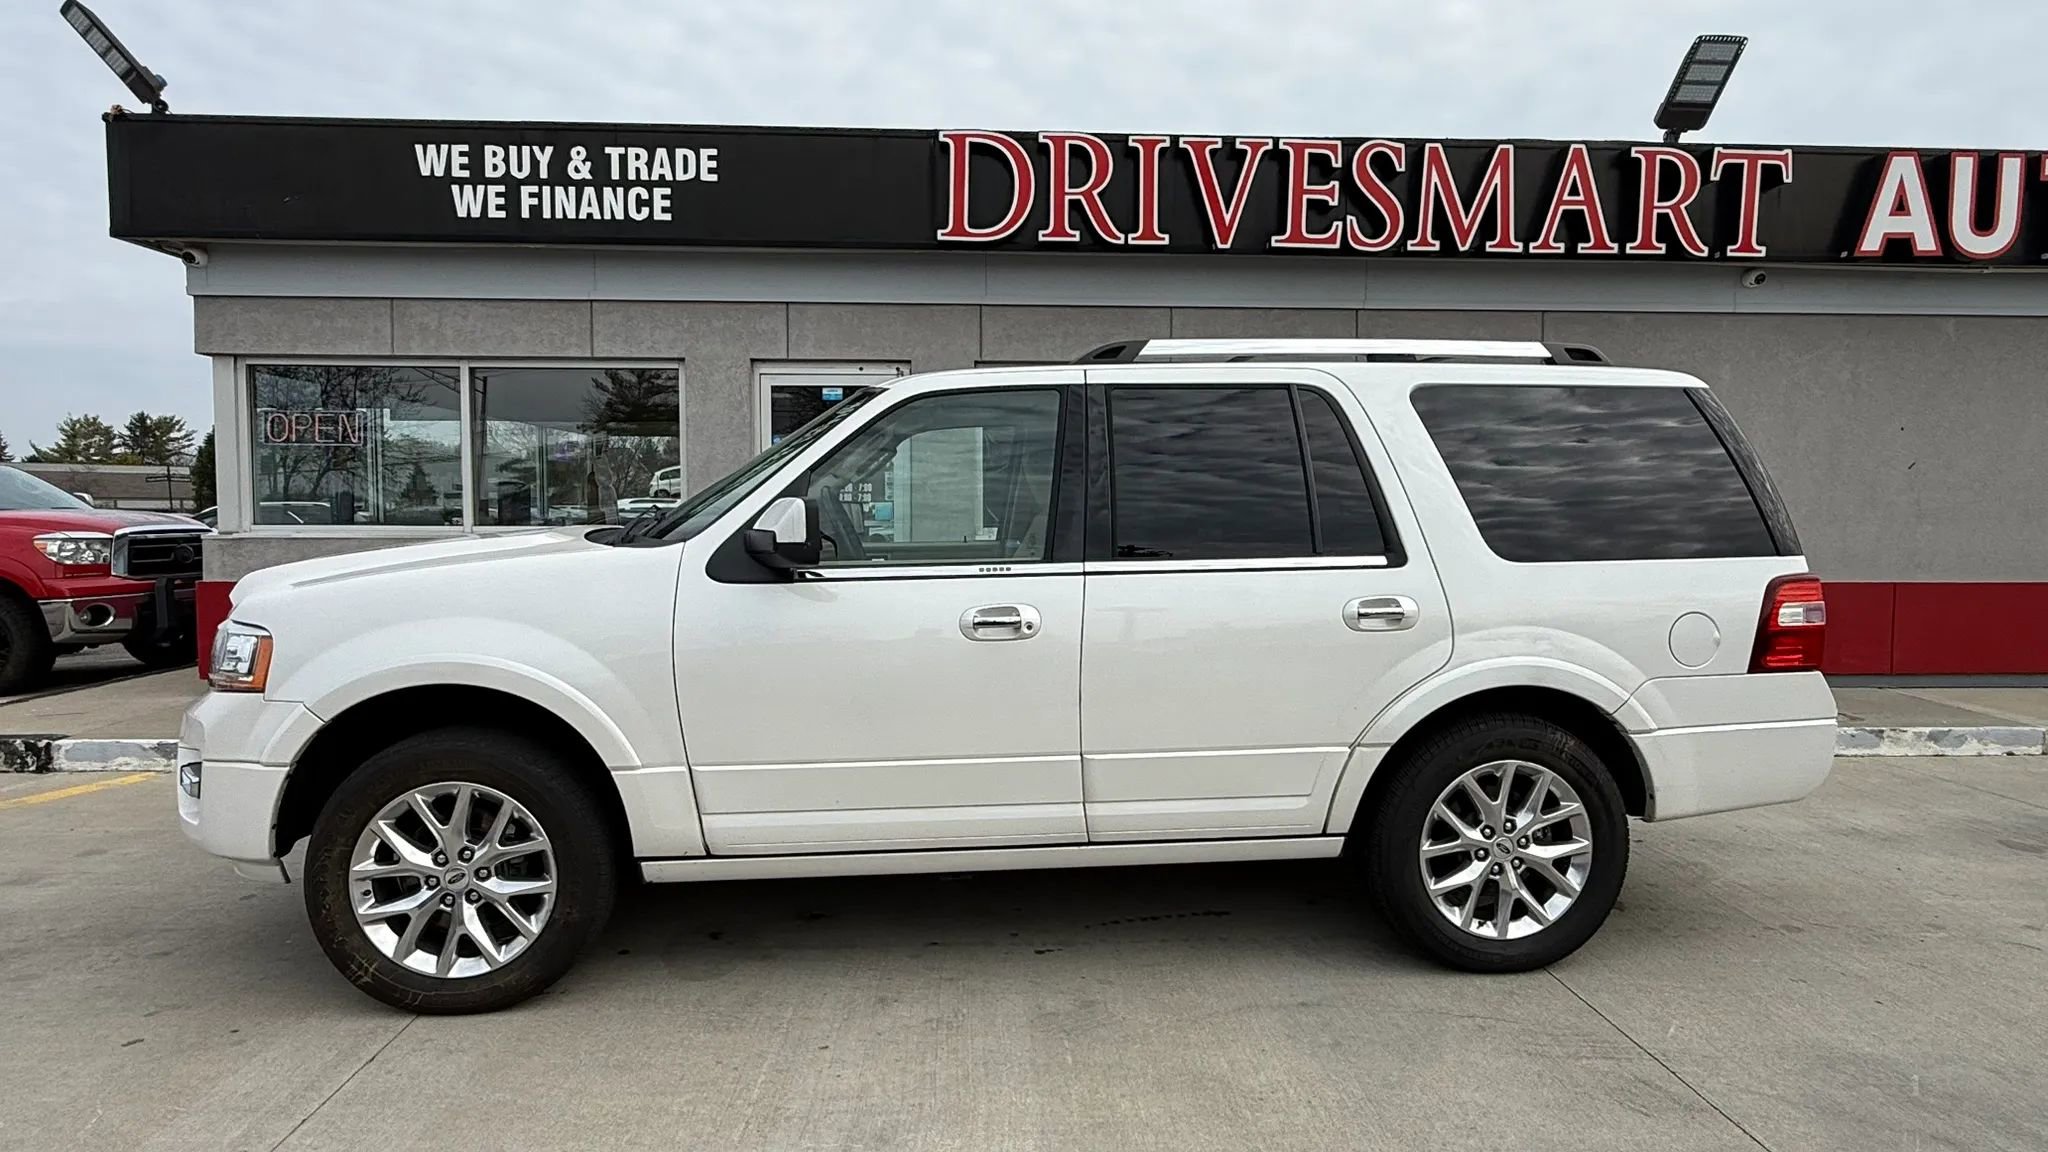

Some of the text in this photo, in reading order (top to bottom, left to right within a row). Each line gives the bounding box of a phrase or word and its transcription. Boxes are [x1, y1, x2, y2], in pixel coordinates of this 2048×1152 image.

[414, 144, 719, 182] WE BUY & TRADE
[451, 184, 673, 221] WE FINANCE
[937, 130, 2048, 260] DRIVESMART AU
[267, 413, 360, 443] OPEN
